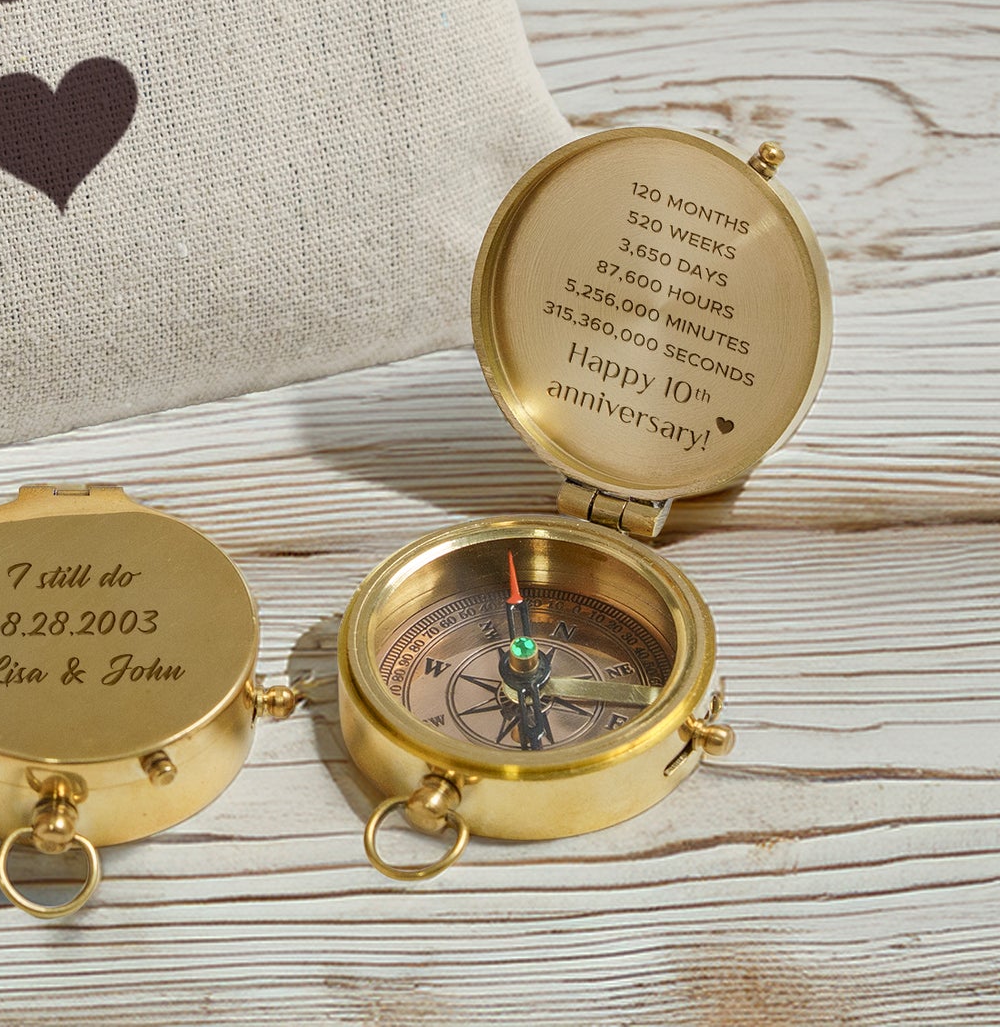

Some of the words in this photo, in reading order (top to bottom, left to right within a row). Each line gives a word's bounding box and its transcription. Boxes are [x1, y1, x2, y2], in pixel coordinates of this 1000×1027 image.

[631, 182, 661, 203] 120
[667, 194, 750, 235] MONTHS
[627, 210, 663, 233] 520
[670, 224, 737, 260] WEEKS
[618, 238, 672, 267] 3,650
[678, 258, 728, 287] DAYS
[596, 260, 662, 293] 87,600
[667, 285, 735, 319] HOURS
[564, 278, 660, 322] 5,256,000
[666, 314, 751, 355] MINUTES
[543, 300, 658, 352] 315,360,000
[663, 344, 755, 387] SECONDS
[568, 342, 656, 395] Happy
[664, 376, 711, 405] 10th
[546, 379, 711, 452] anniversary!
[7, 562, 32, 589] I
[36, 564, 91, 589] still
[99, 564, 141, 588] do
[0, 610, 159, 638] 8.28.2003
[422, 626, 440, 639] 70
[440, 616, 457, 628] 60
[549, 620, 577, 641] N
[409, 639, 425, 653] 80
[621, 631, 639, 646] 30
[61, 657, 87, 685] &
[101, 653, 186, 686] John
[398, 653, 414, 667] 90
[425, 657, 452, 678] W
[604, 661, 635, 679] NE
[391, 668, 406, 683] 80
[422, 714, 445, 729] W
